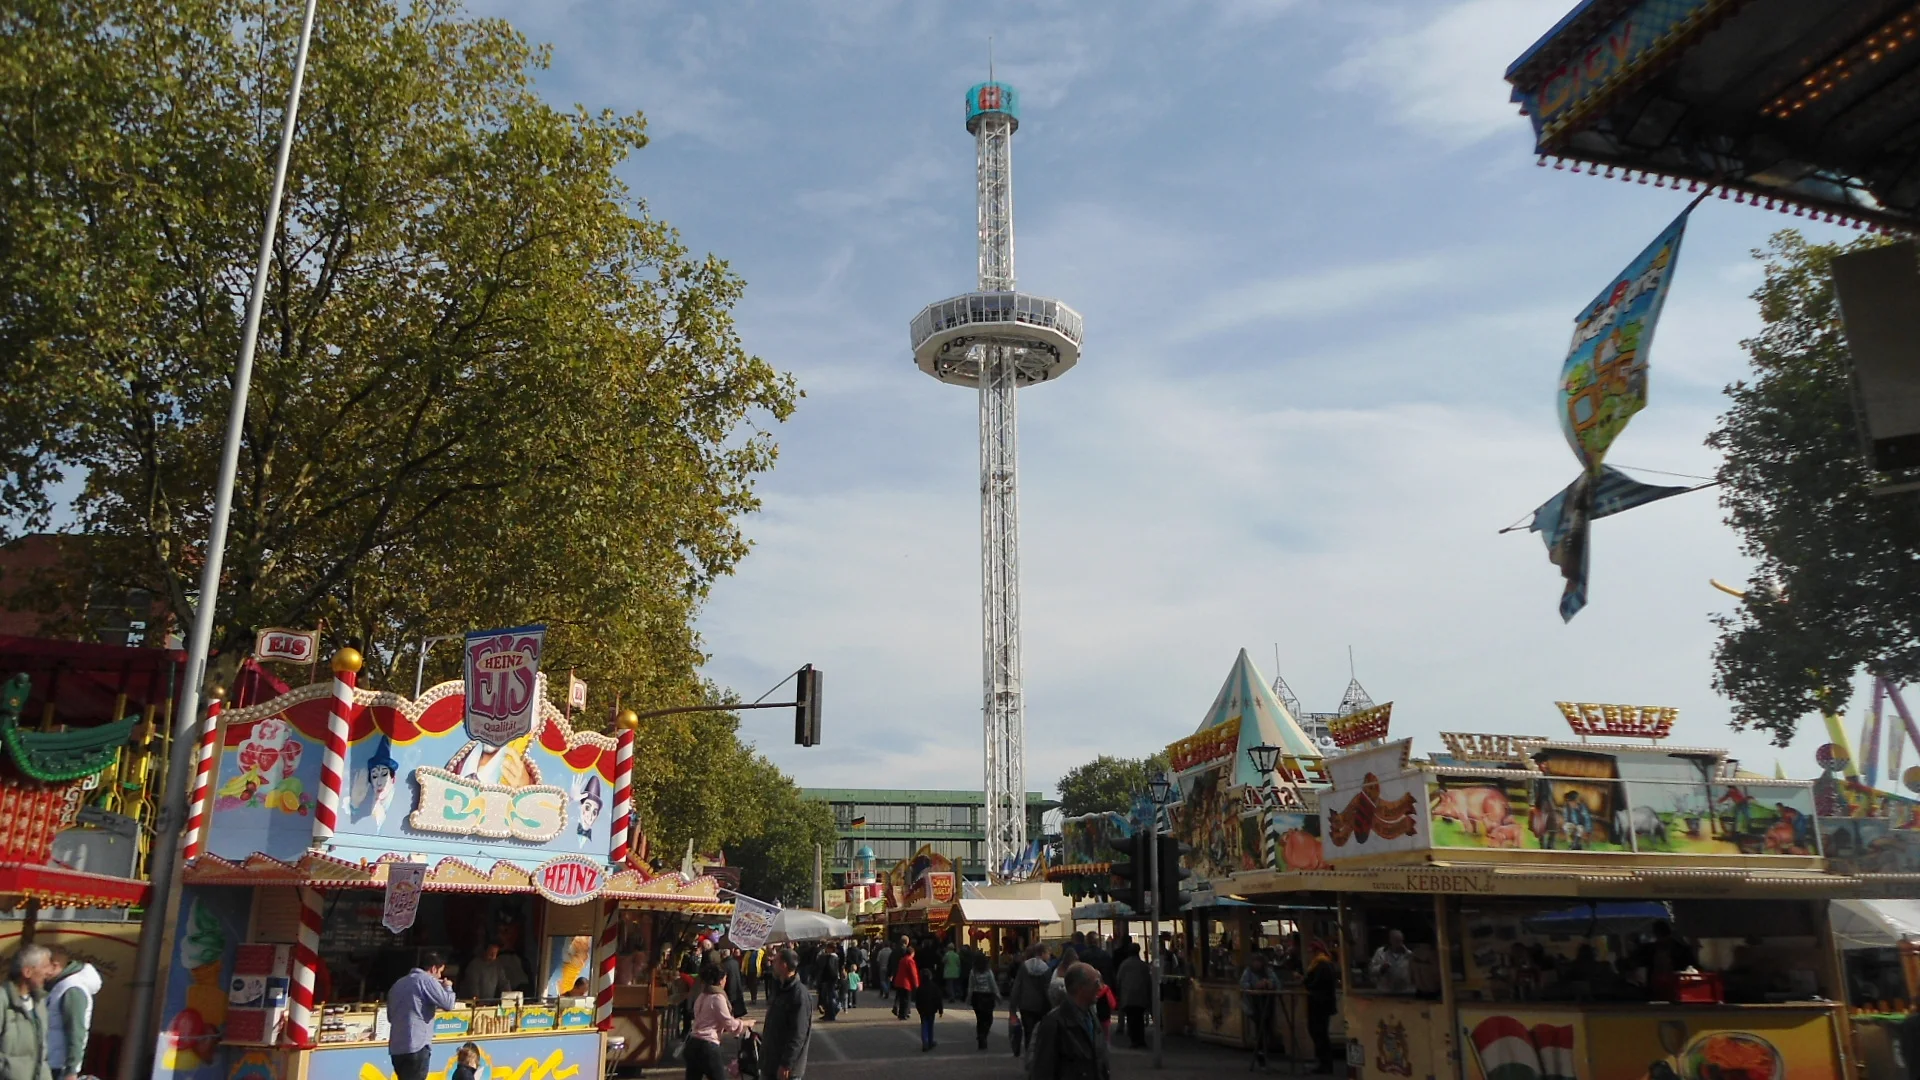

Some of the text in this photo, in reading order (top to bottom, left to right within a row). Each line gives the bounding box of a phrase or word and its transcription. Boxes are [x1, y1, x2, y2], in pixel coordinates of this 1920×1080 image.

[268, 636, 306, 656] EIS
[485, 654, 523, 669] HEINZ
[470, 635, 539, 719] EIS
[483, 721, 517, 732] Qualität
[411, 767, 569, 842] EIS
[543, 863, 598, 896] HEINZ
